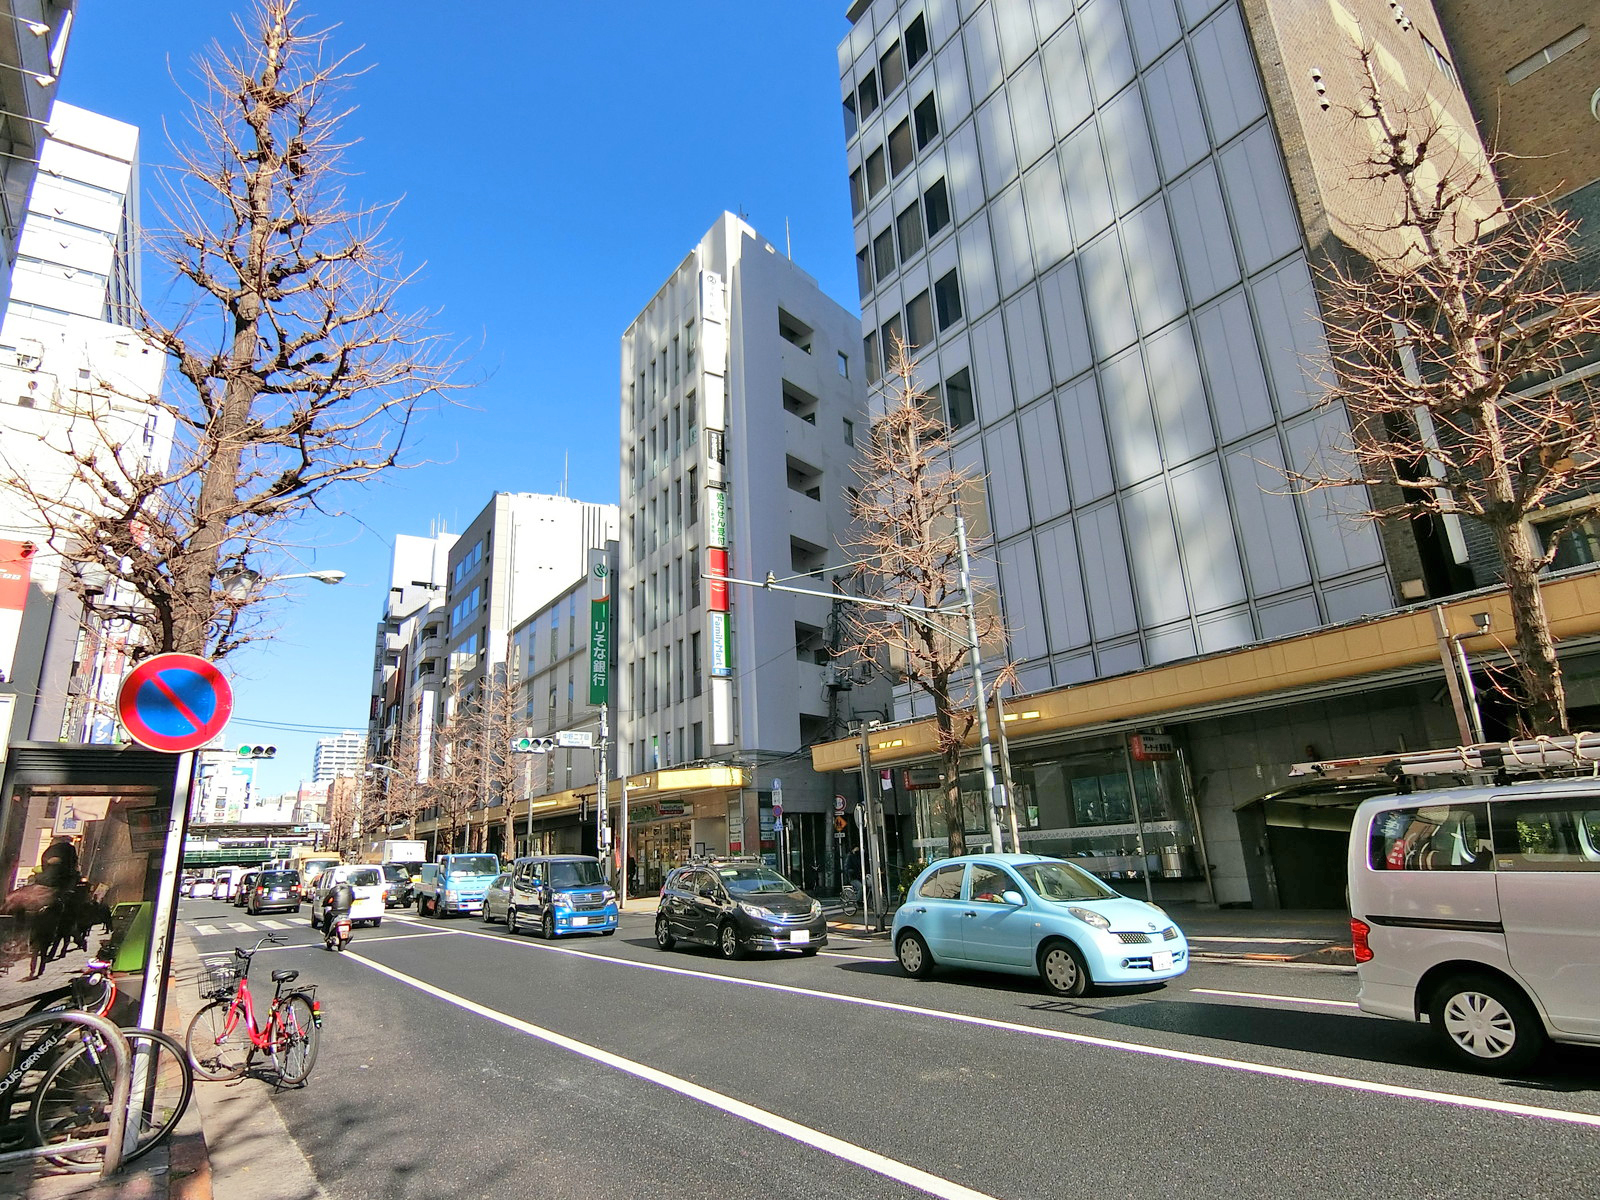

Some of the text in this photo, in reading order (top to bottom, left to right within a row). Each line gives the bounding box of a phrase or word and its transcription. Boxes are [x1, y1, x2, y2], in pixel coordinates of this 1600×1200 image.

[593, 621, 606, 686] りそな銀行
[715, 615, 724, 666] FamilyMart
